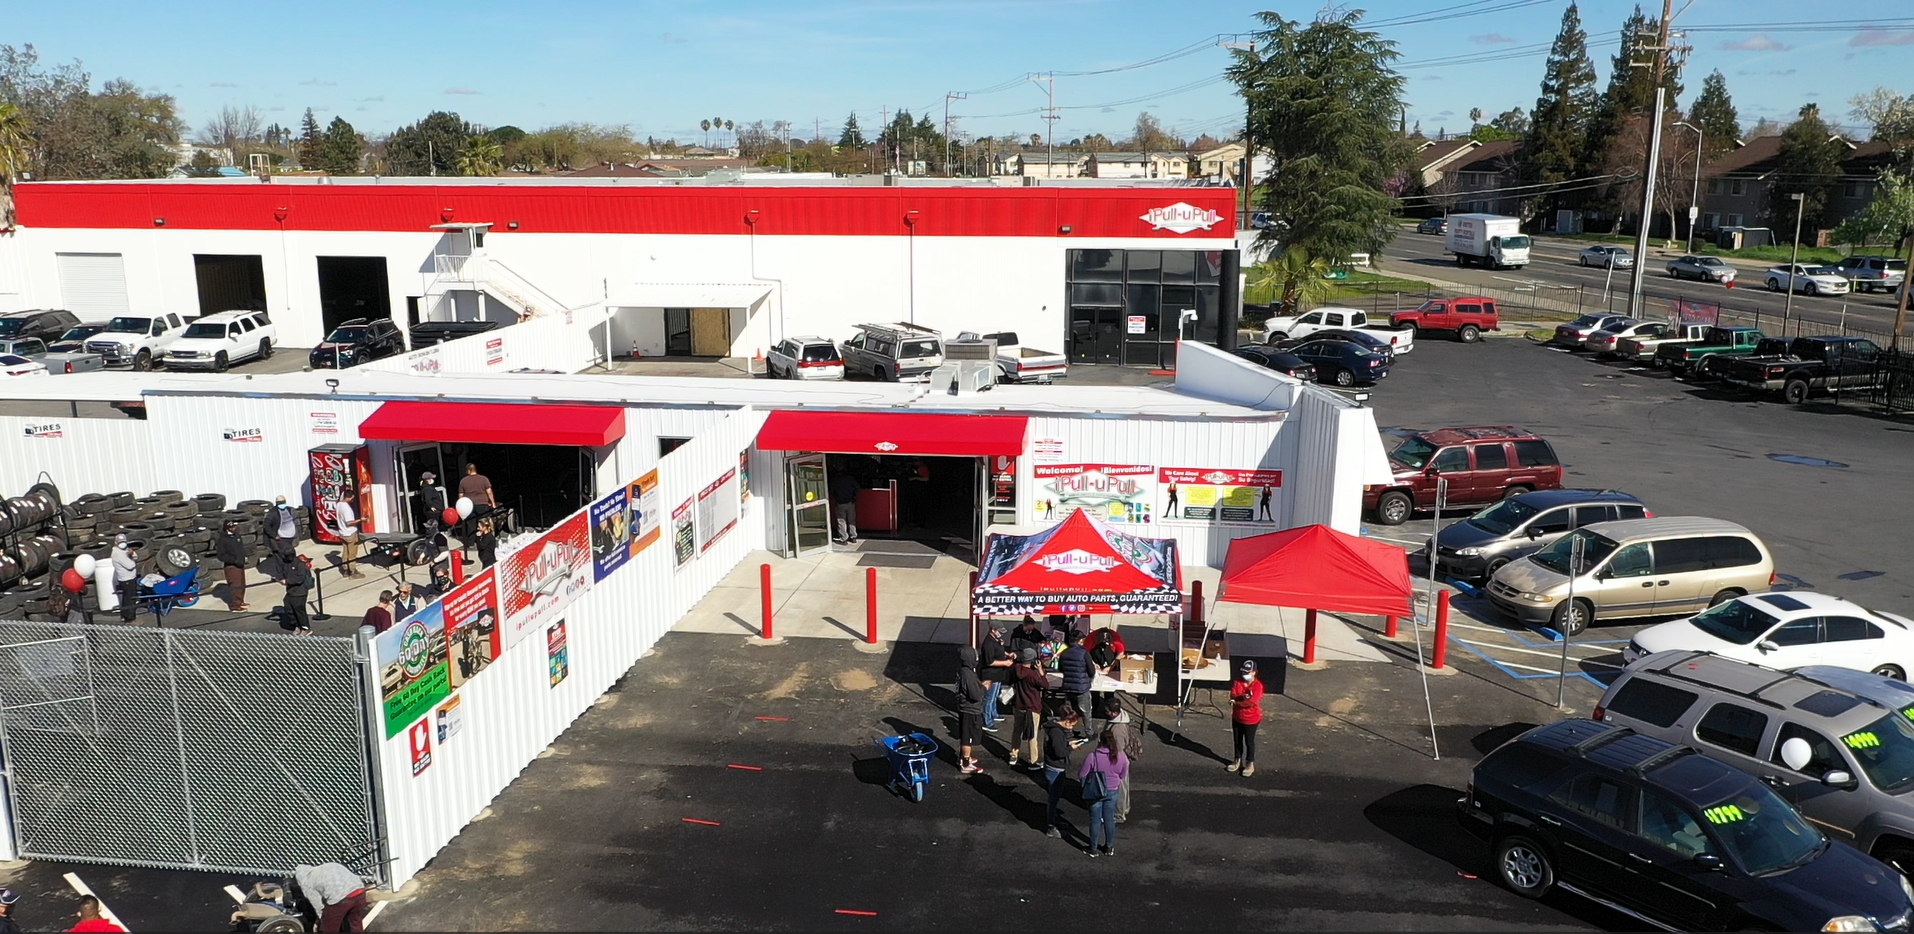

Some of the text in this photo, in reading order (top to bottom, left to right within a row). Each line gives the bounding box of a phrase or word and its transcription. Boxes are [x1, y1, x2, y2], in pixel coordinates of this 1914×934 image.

[34, 424, 61, 433] TIRES
[232, 428, 261, 438] TIRES
[1036, 466, 1083, 474] Welcome!
[977, 593, 1179, 604] A BETTER WAY TO BUY AUTO PARTS, GUARANTEED!
